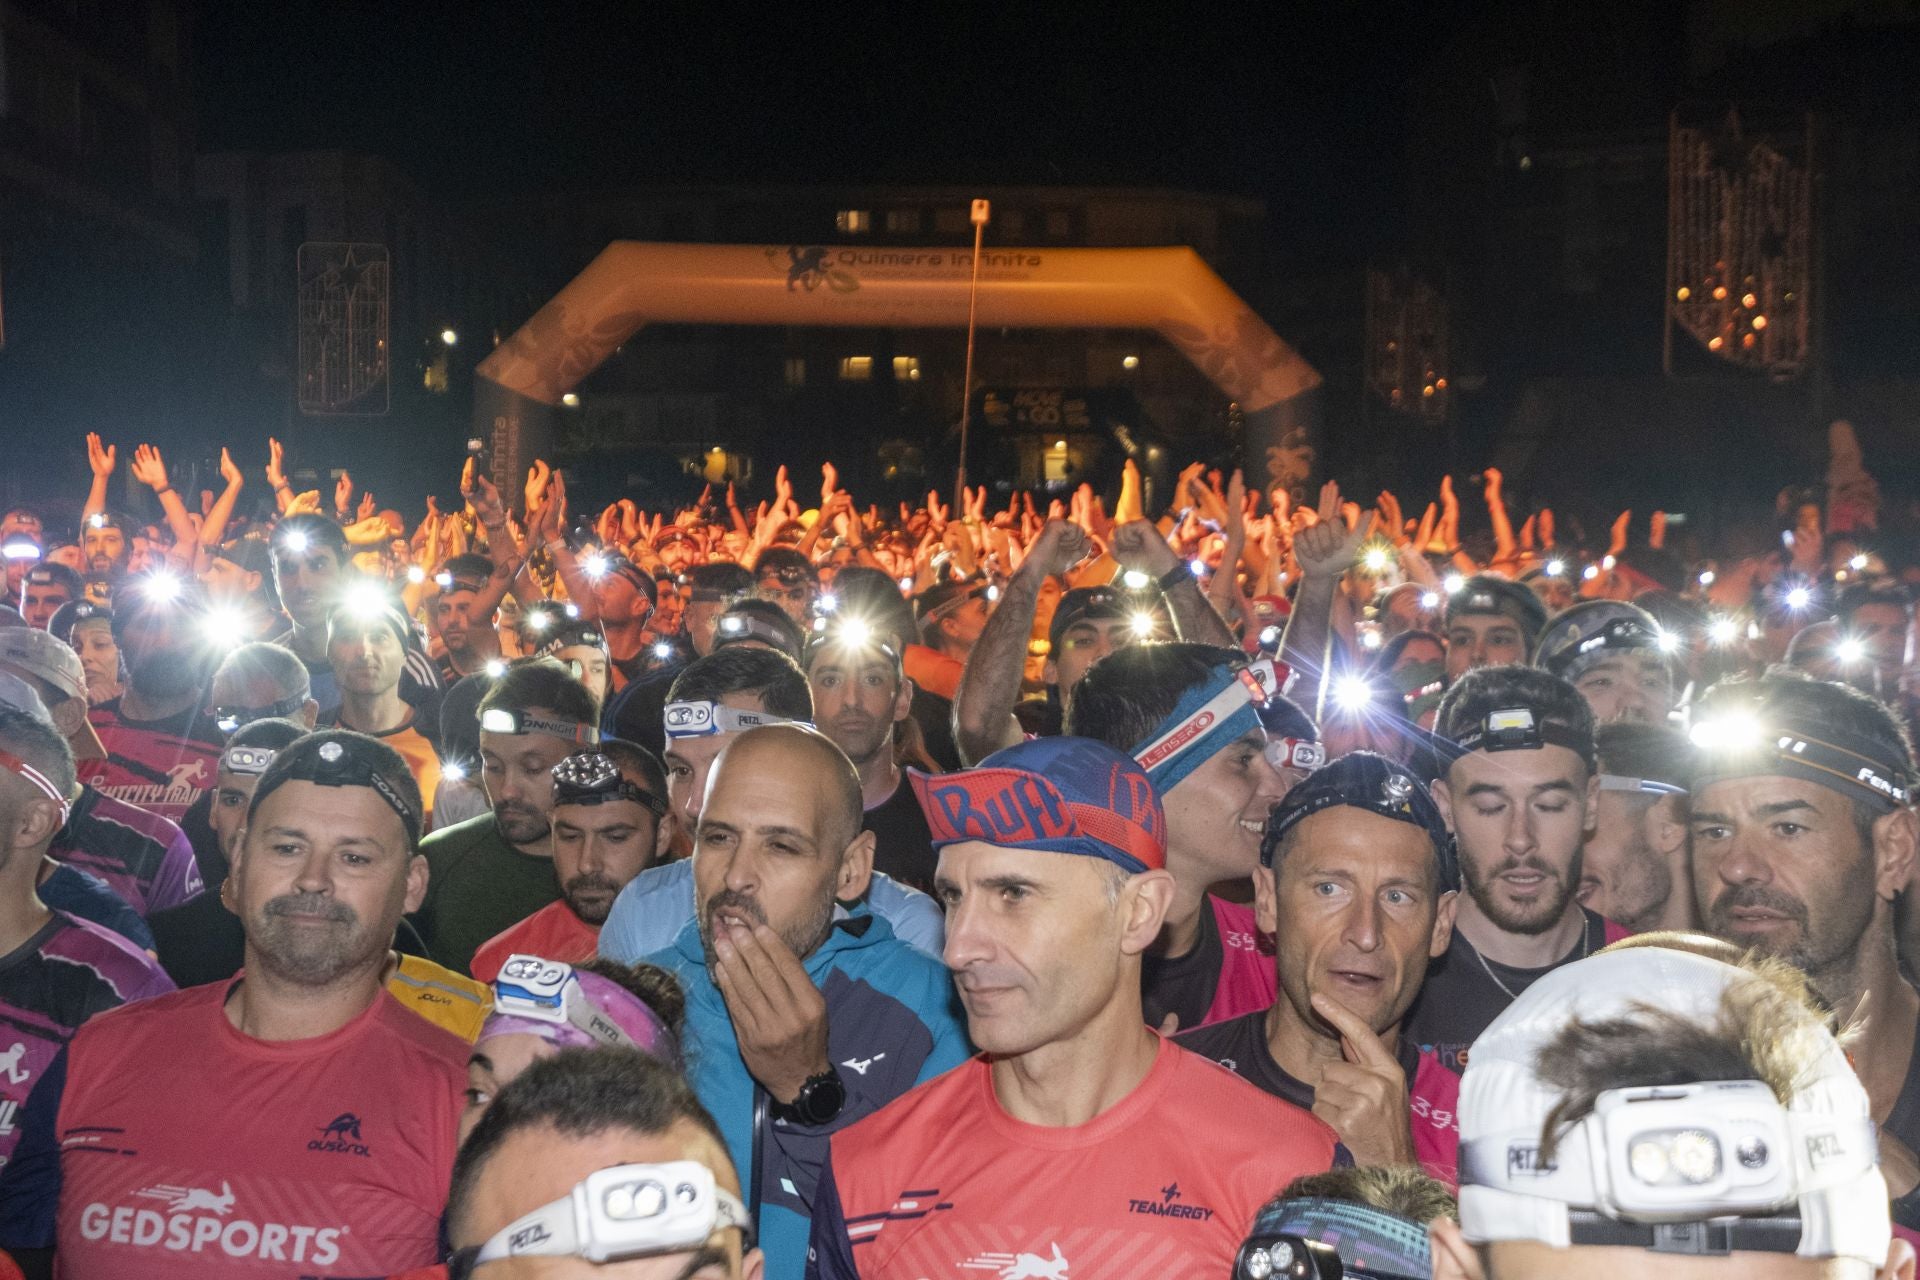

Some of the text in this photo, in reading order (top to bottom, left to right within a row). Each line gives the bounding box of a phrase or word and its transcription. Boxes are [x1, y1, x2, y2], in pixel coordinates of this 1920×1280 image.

[838, 250, 942, 266] Quimera
[1129, 1199, 1213, 1221] TEAMERGY
[80, 1202, 341, 1266] GEDSPORTS
